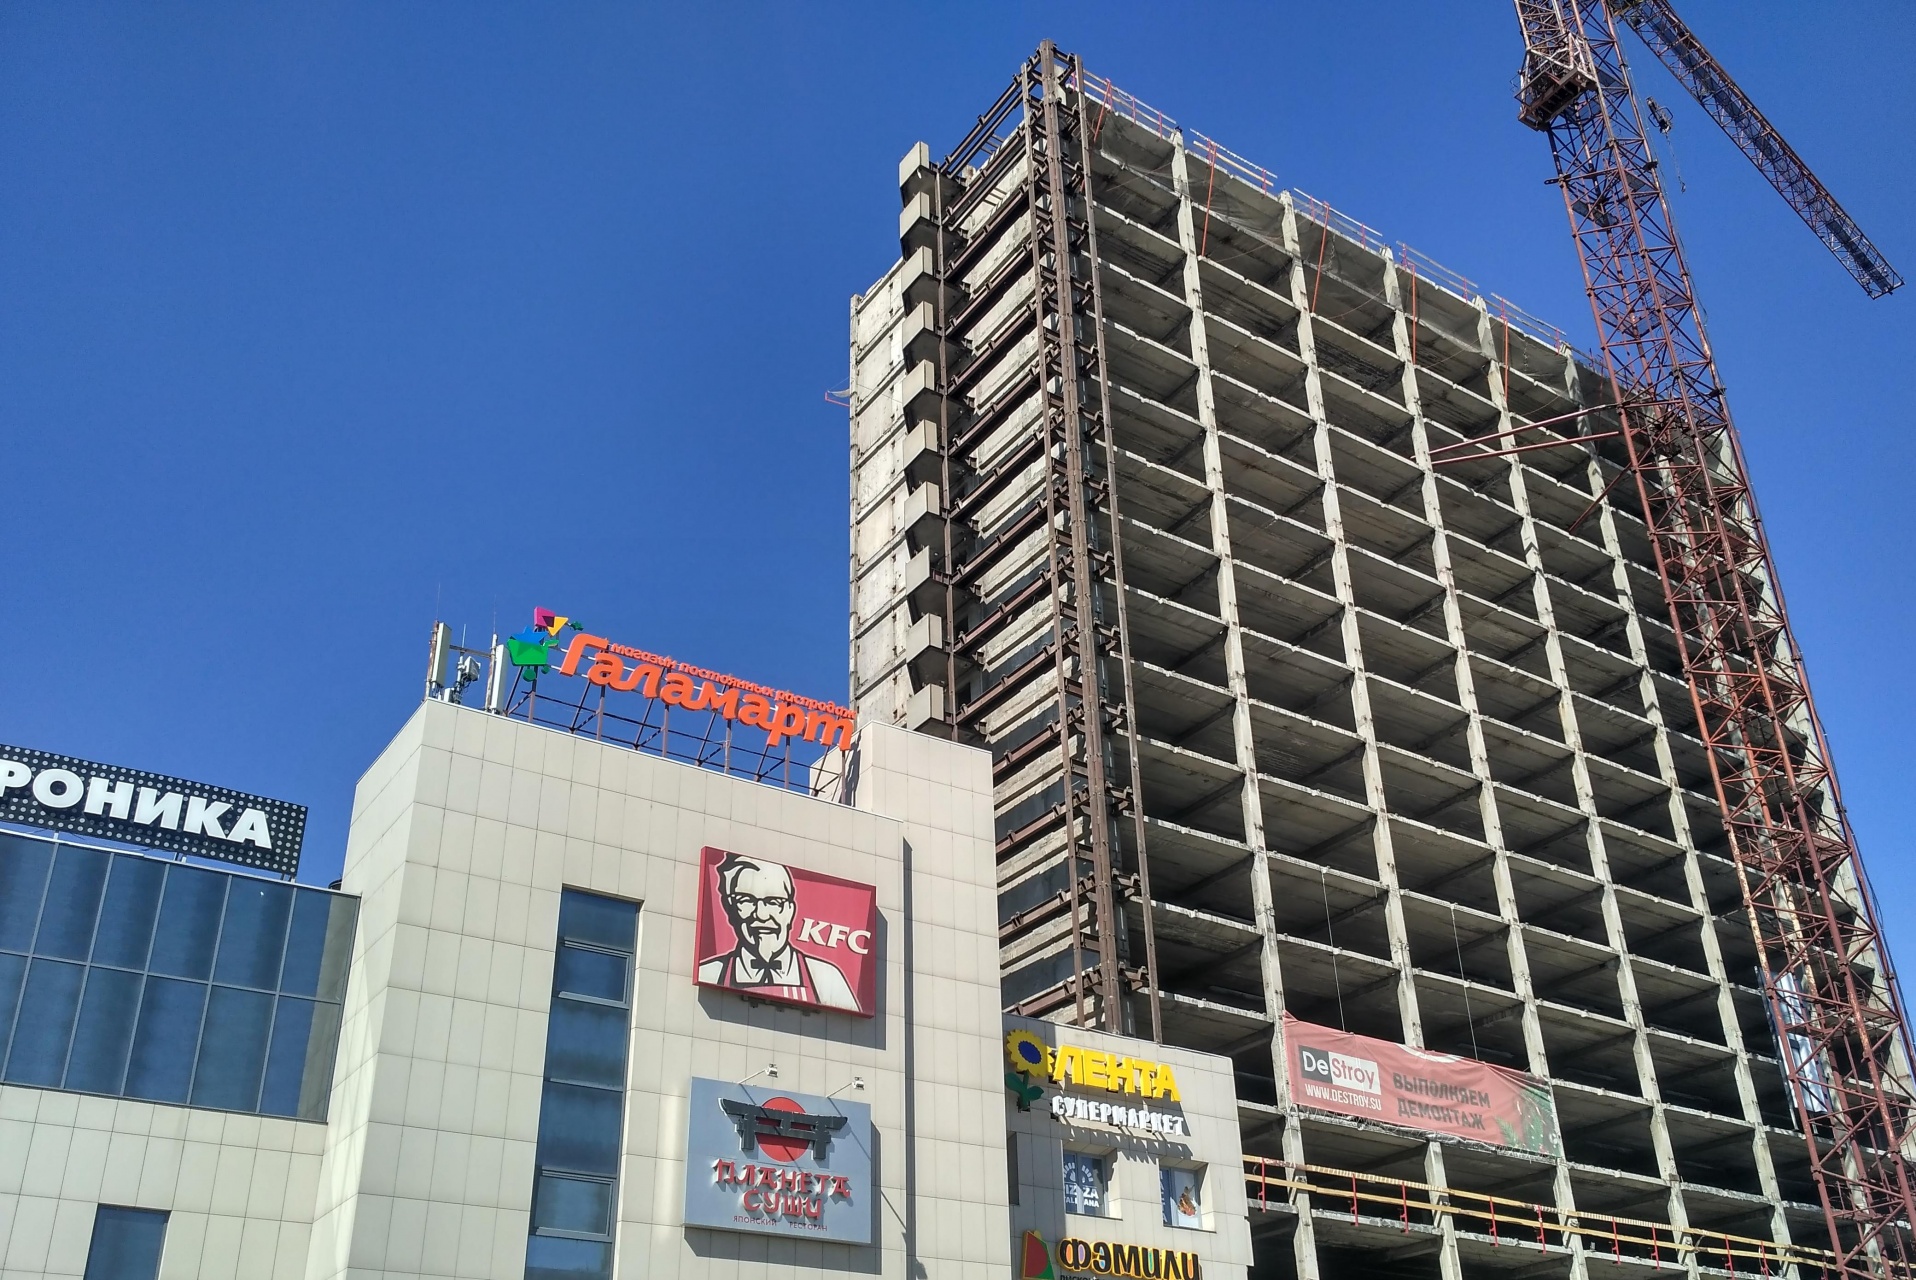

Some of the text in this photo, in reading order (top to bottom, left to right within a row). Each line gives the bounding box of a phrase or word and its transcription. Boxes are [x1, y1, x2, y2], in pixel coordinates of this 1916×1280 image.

[611, 643, 677, 669] магазин
[679, 662, 775, 697] постоянных
[560, 633, 854, 751] Галамарт
[0, 759, 272, 849] РОНИКА
[799, 918, 871, 955] KFC
[1053, 1045, 1181, 1102] ЛЕНТА
[1303, 1049, 1375, 1090] DeStroy
[1305, 1083, 1382, 1111] WWW.DESTROY.SU
[1393, 1072, 1490, 1109] ВЫПОЛНЯЕМ
[1053, 1095, 1184, 1136] СУПЕРМАРКЕТ
[1398, 1098, 1486, 1130] ДЕМОНТАЖ
[713, 1158, 851, 1198] ПЛАНЕТА
[1065, 1184, 1099, 1199] IZZA
[743, 1189, 822, 1219] СУШИ
[733, 1215, 828, 1232] ЯПОНСКИЙ РЕСТОРАН
